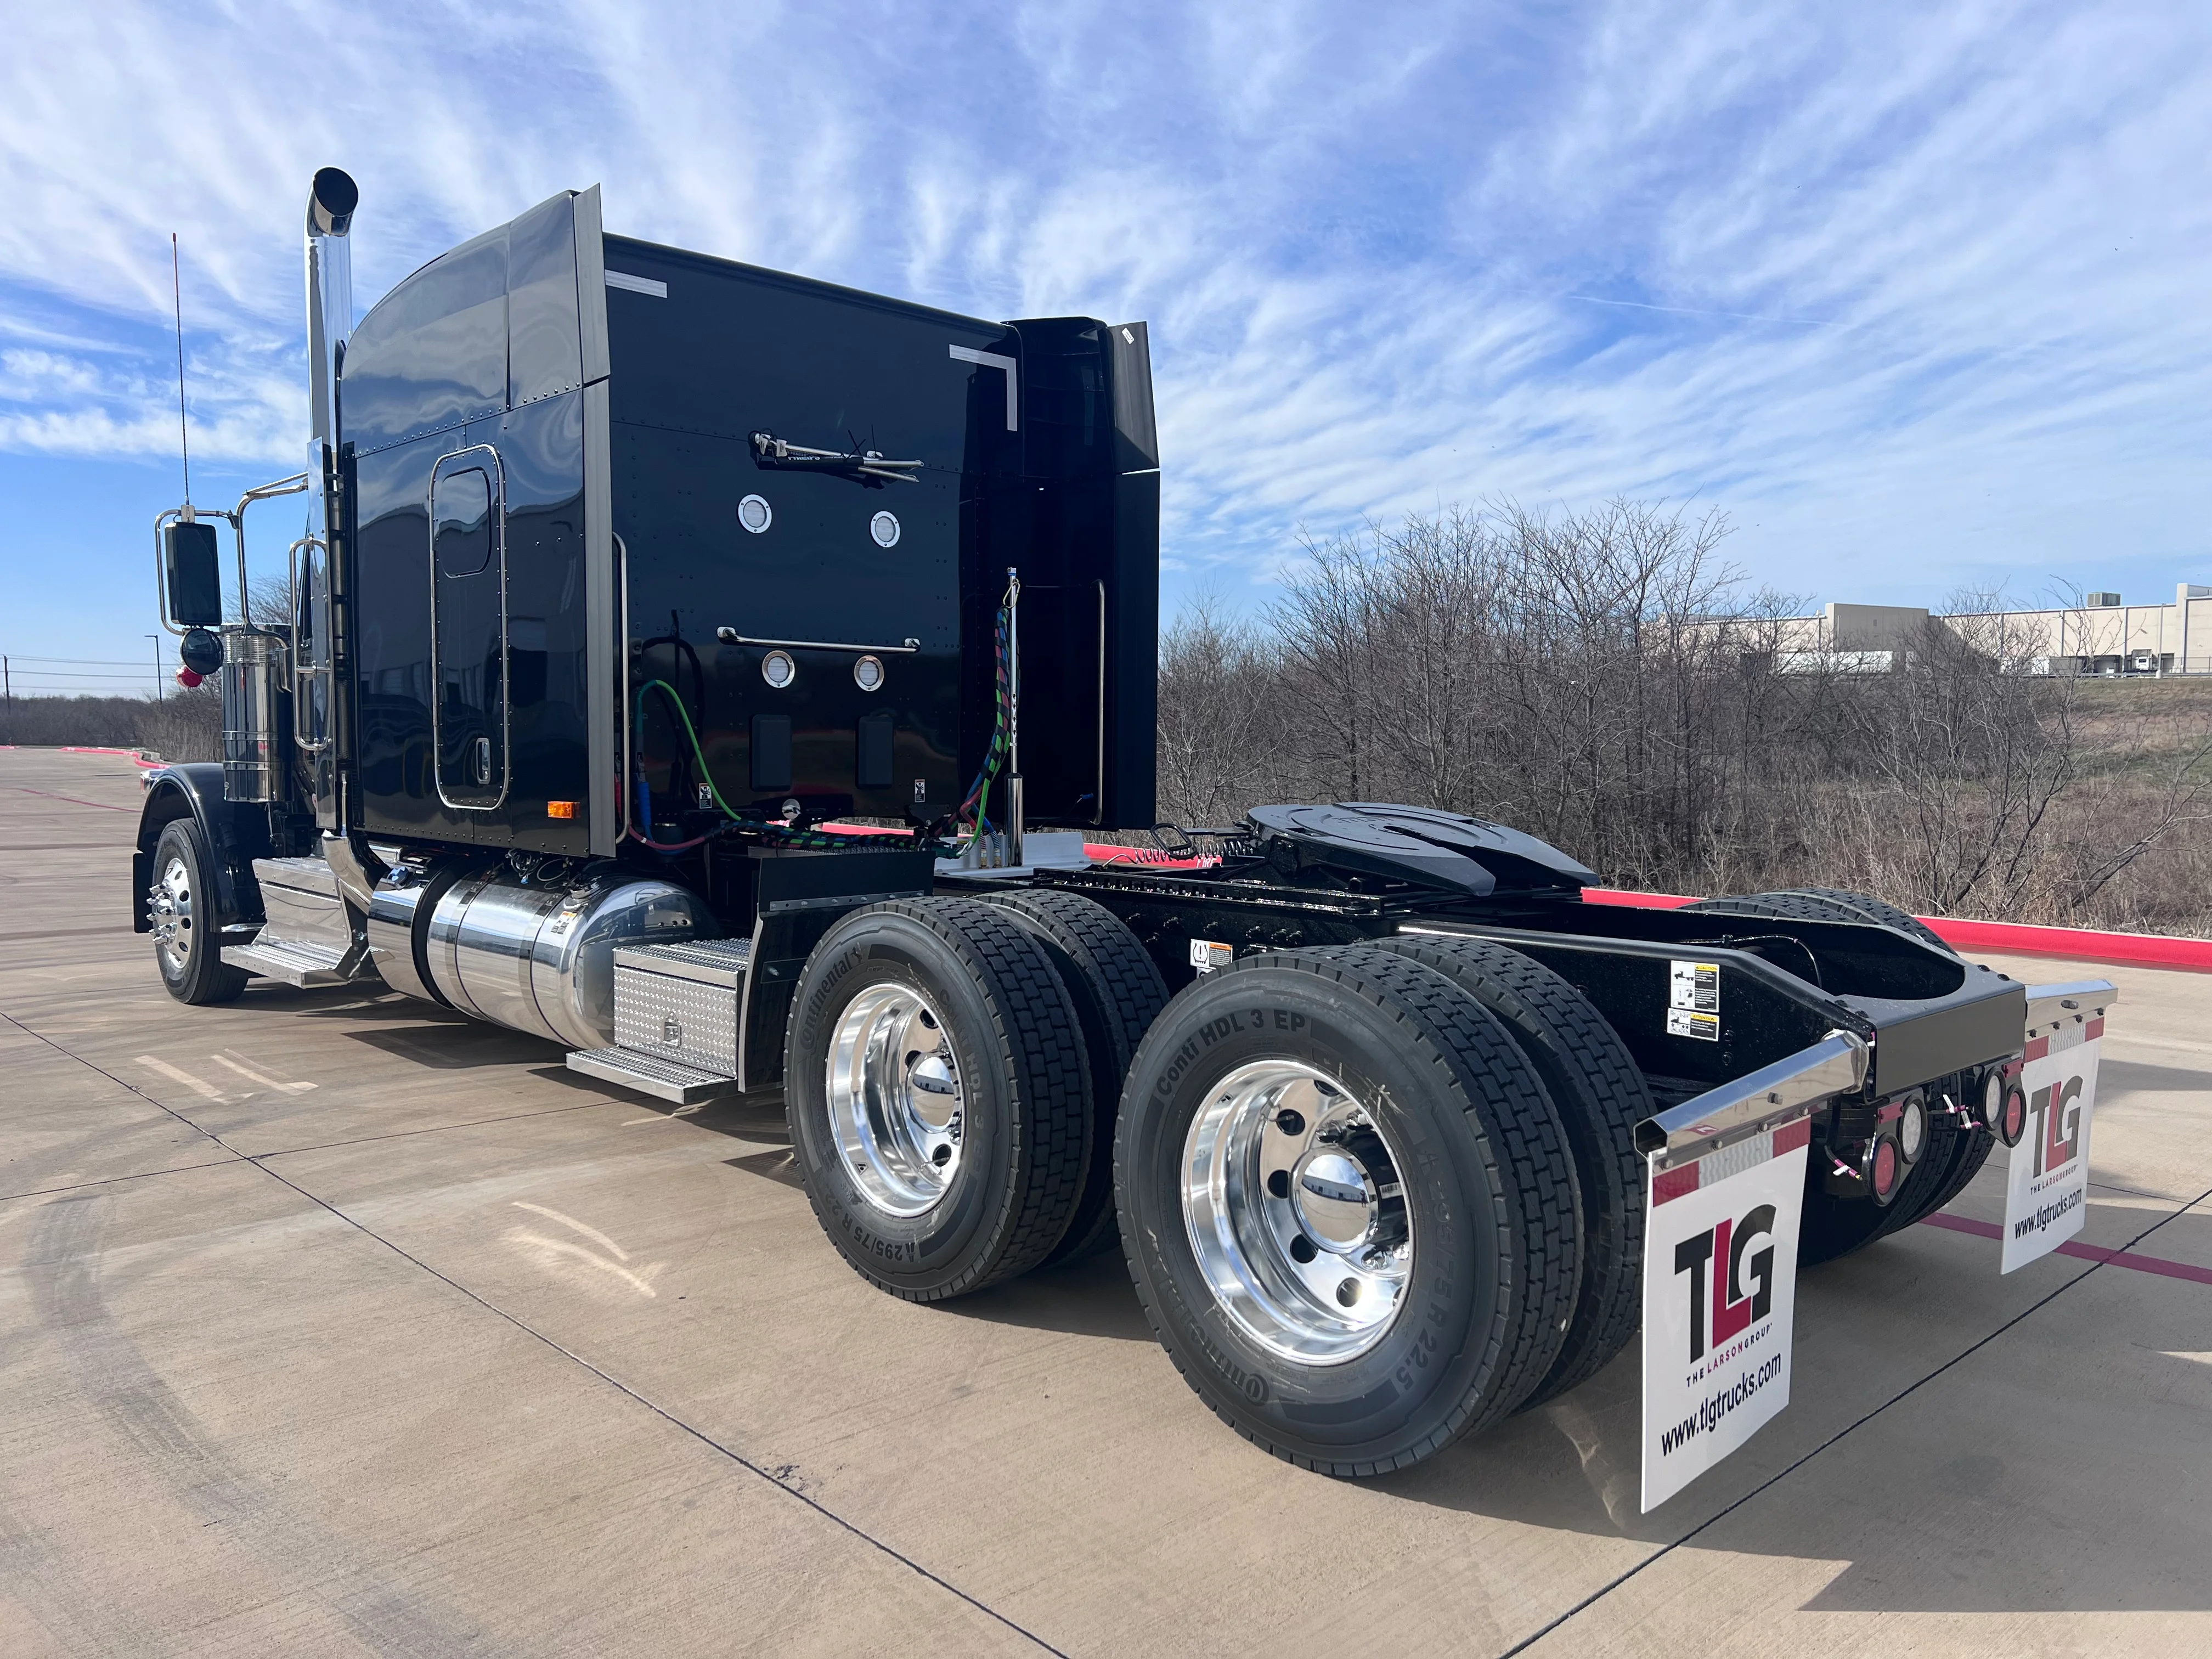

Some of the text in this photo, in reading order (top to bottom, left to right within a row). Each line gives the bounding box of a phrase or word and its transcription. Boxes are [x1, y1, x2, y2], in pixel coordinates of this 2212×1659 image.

[799, 950, 853, 1050] Continental
[966, 1052, 983, 1105] HDL
[1156, 1008, 1306, 1096] Conti HDL 3 EP
[2030, 1075, 2083, 1179] TLG
[2015, 1188, 2082, 1239] www.tlgtrucks.com
[2030, 1183, 2040, 1195] THE
[842, 1212, 854, 1233] R
[853, 1226, 903, 1262] 295/75
[1675, 1204, 1777, 1364] TLG
[1428, 1302, 1448, 1329] R
[1396, 1328, 1437, 1392] 22.5
[1686, 1367, 1705, 1388] THE
[1661, 1352, 1781, 1457] www.tlgtrucks.com
